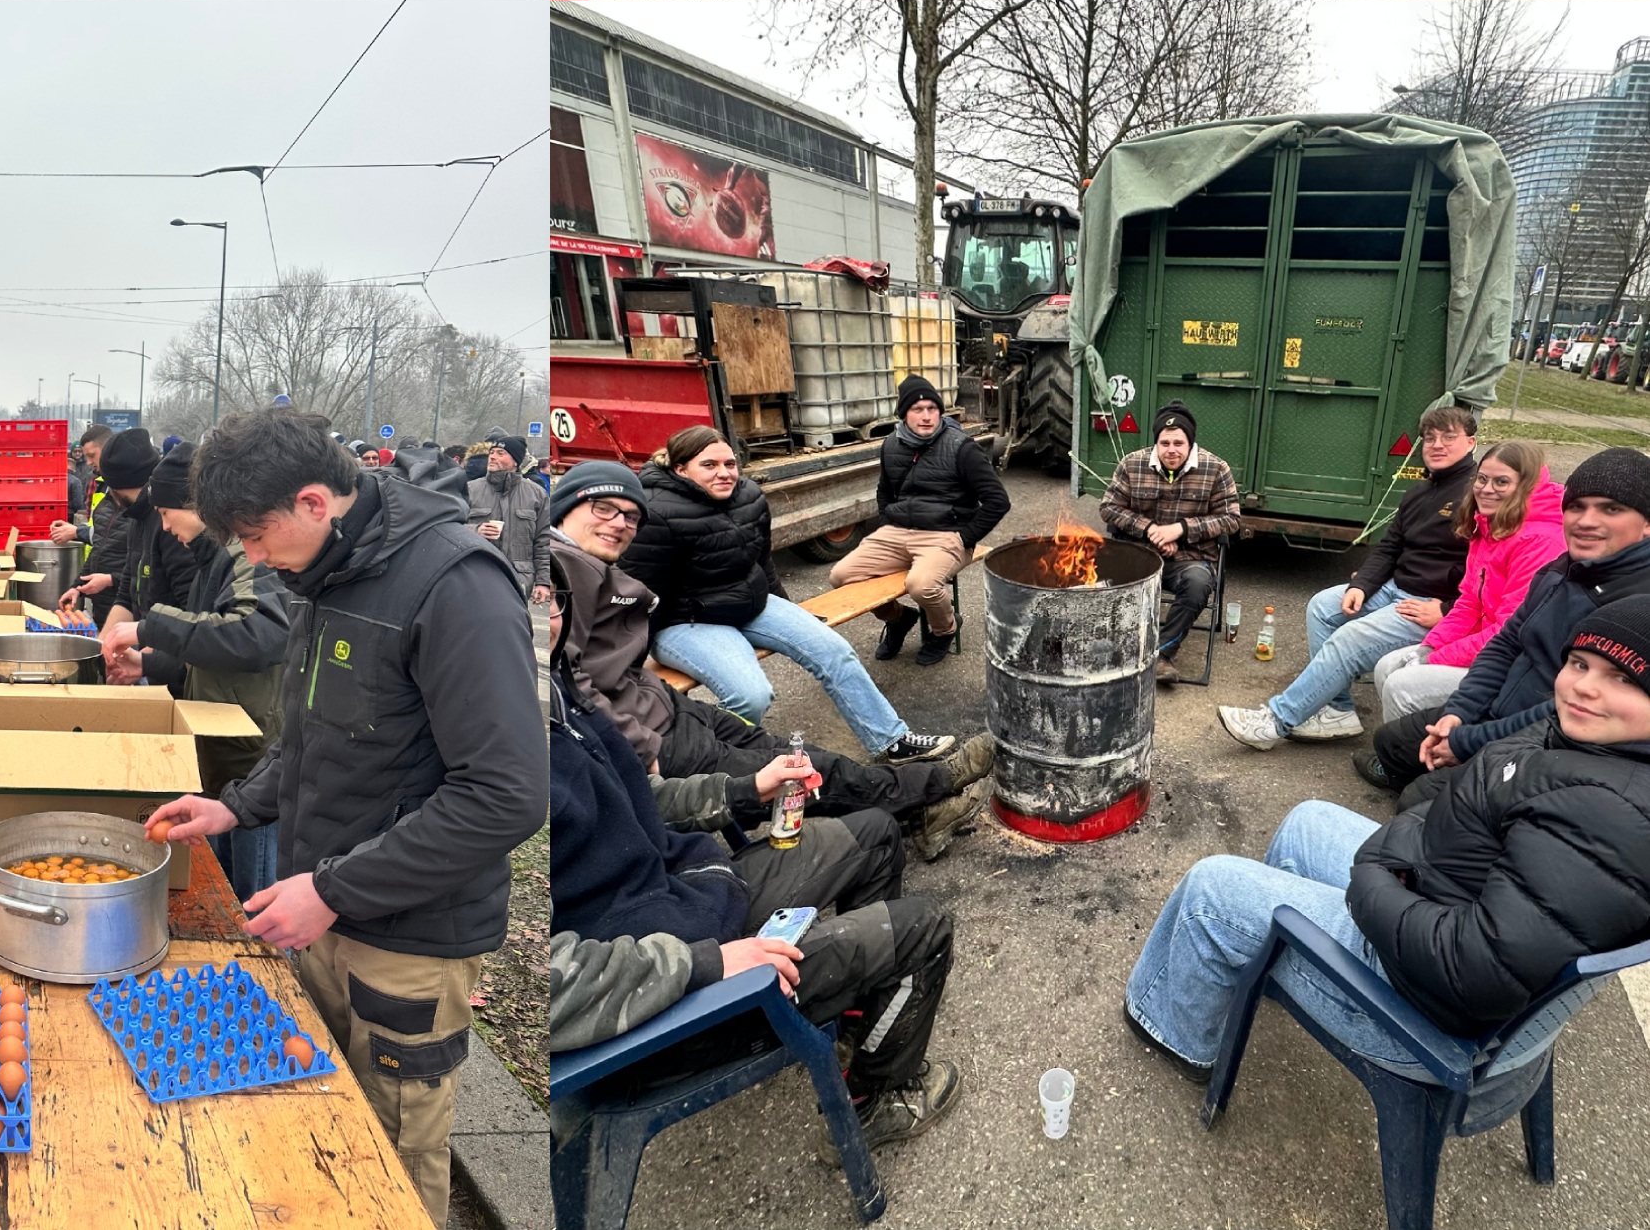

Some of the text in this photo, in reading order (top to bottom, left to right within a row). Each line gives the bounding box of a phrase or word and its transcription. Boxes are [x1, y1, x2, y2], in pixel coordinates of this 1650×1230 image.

[1110, 378, 1129, 403] 25
[555, 411, 571, 438] 25
[379, 1054, 400, 1069] site
